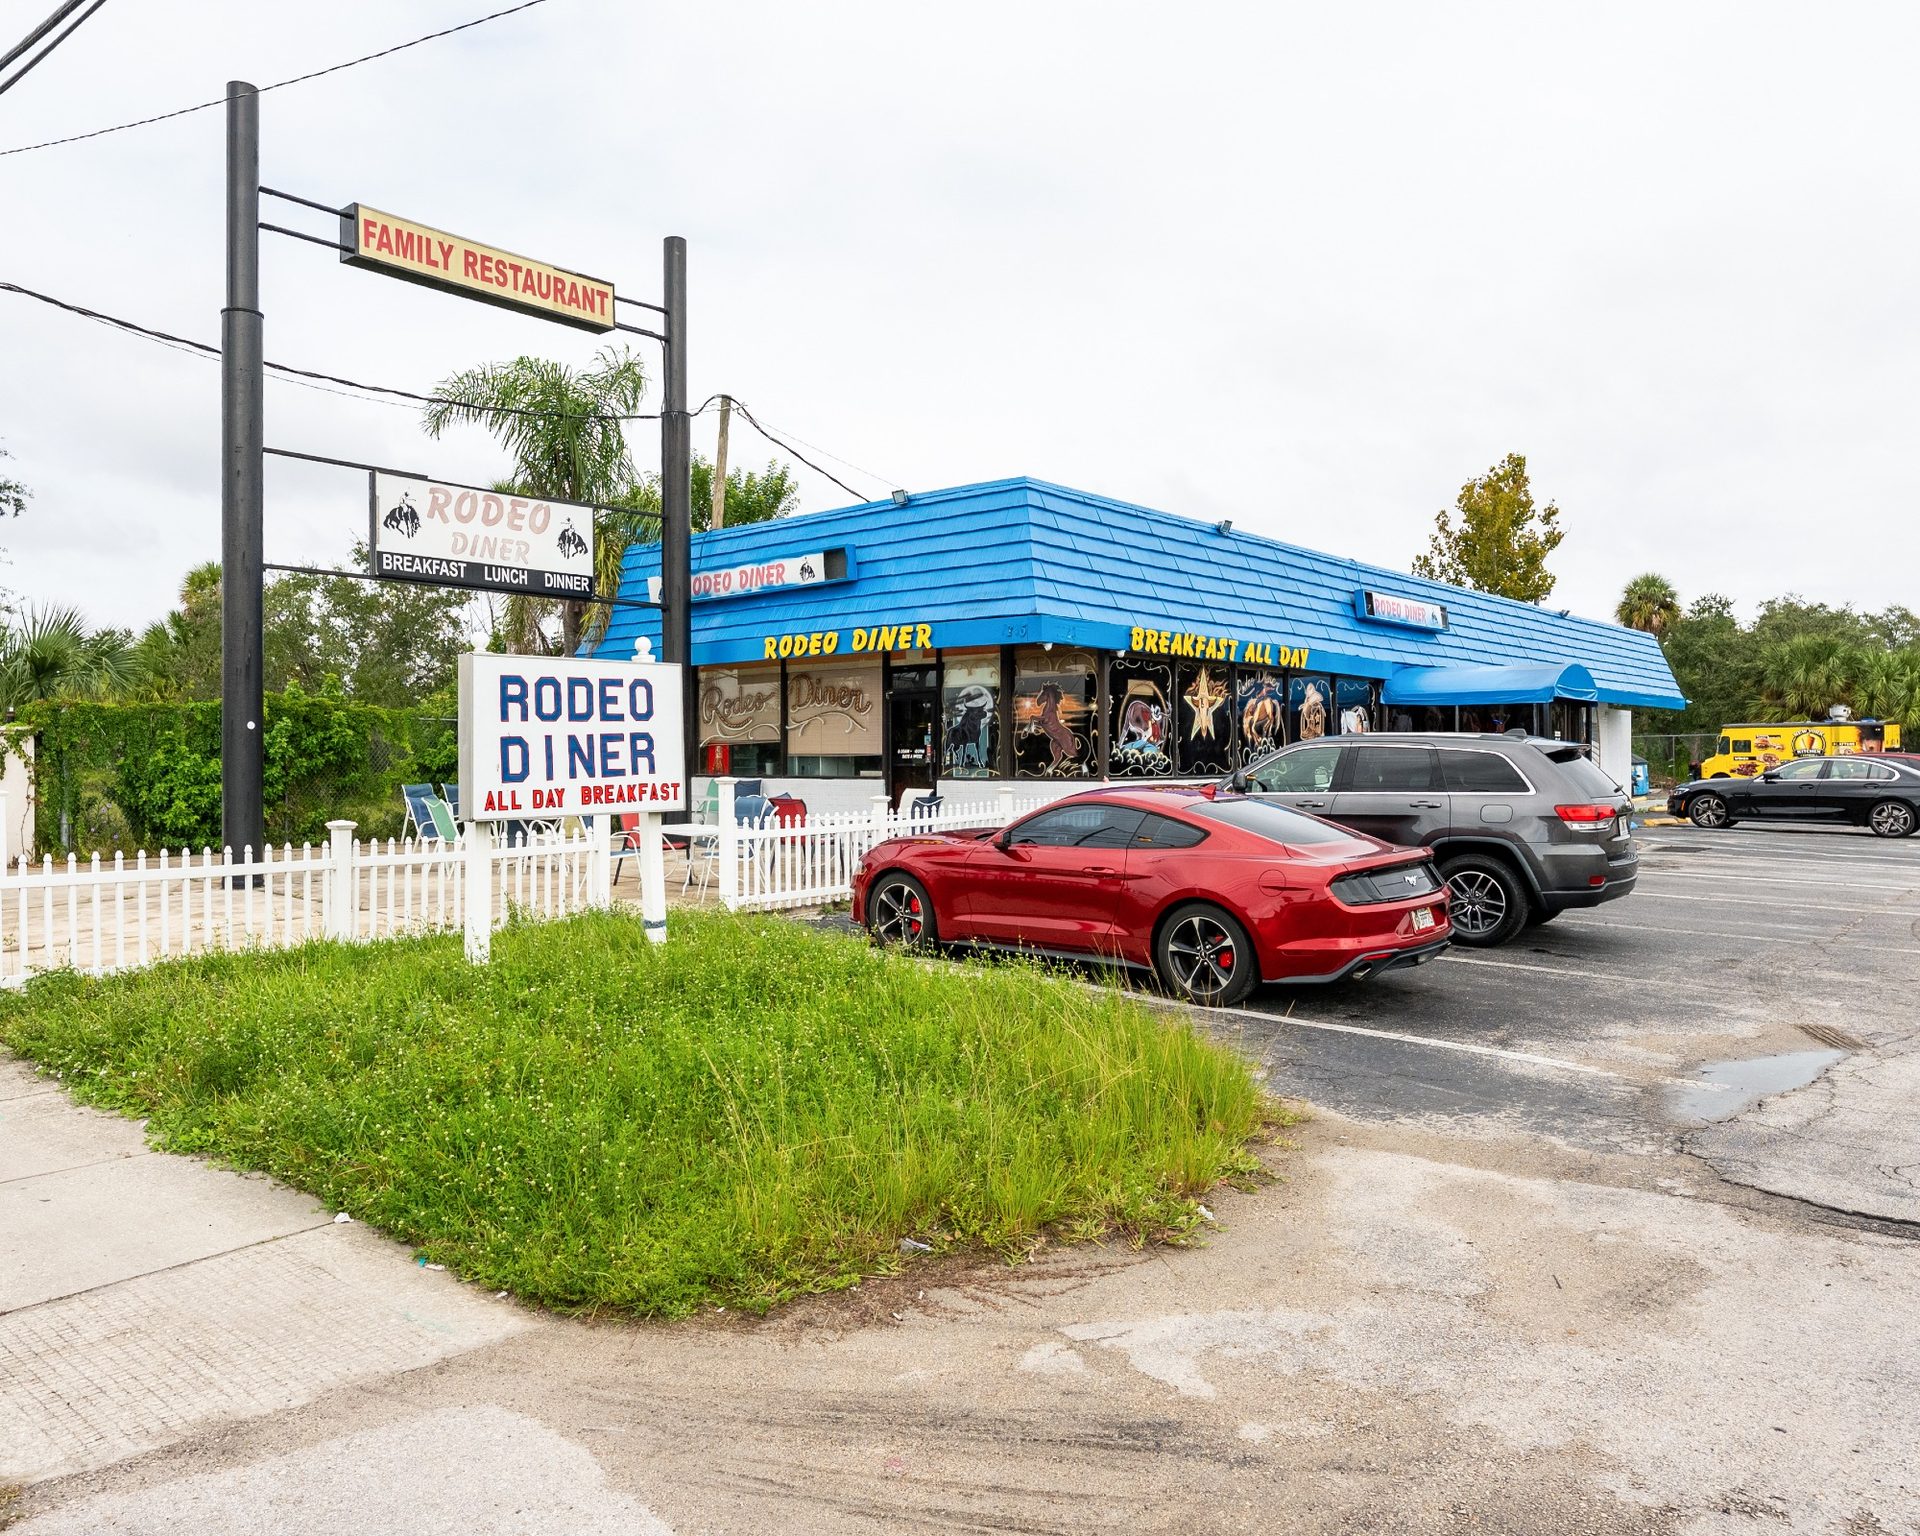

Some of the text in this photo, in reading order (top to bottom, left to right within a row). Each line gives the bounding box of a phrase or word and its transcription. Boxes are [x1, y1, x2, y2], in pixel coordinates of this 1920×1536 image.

[363, 218, 609, 316] FAMILY RESTAURANT
[427, 487, 551, 535] RODEO
[451, 531, 530, 565] DINER
[382, 553, 590, 592] BREAKFAST LUNCH DINNER
[692, 563, 785, 596] ODEO DINER
[1374, 598, 1426, 621] RODEO DINER
[764, 624, 932, 659] RODEO DINER
[1131, 626, 1309, 669] BREAKFAST ALL DAY
[500, 675, 654, 722] RODEO
[702, 673, 872, 730] Rodeo Diner
[500, 732, 656, 783] DINER
[484, 782, 681, 811] ALL DAY BREAKFAST
